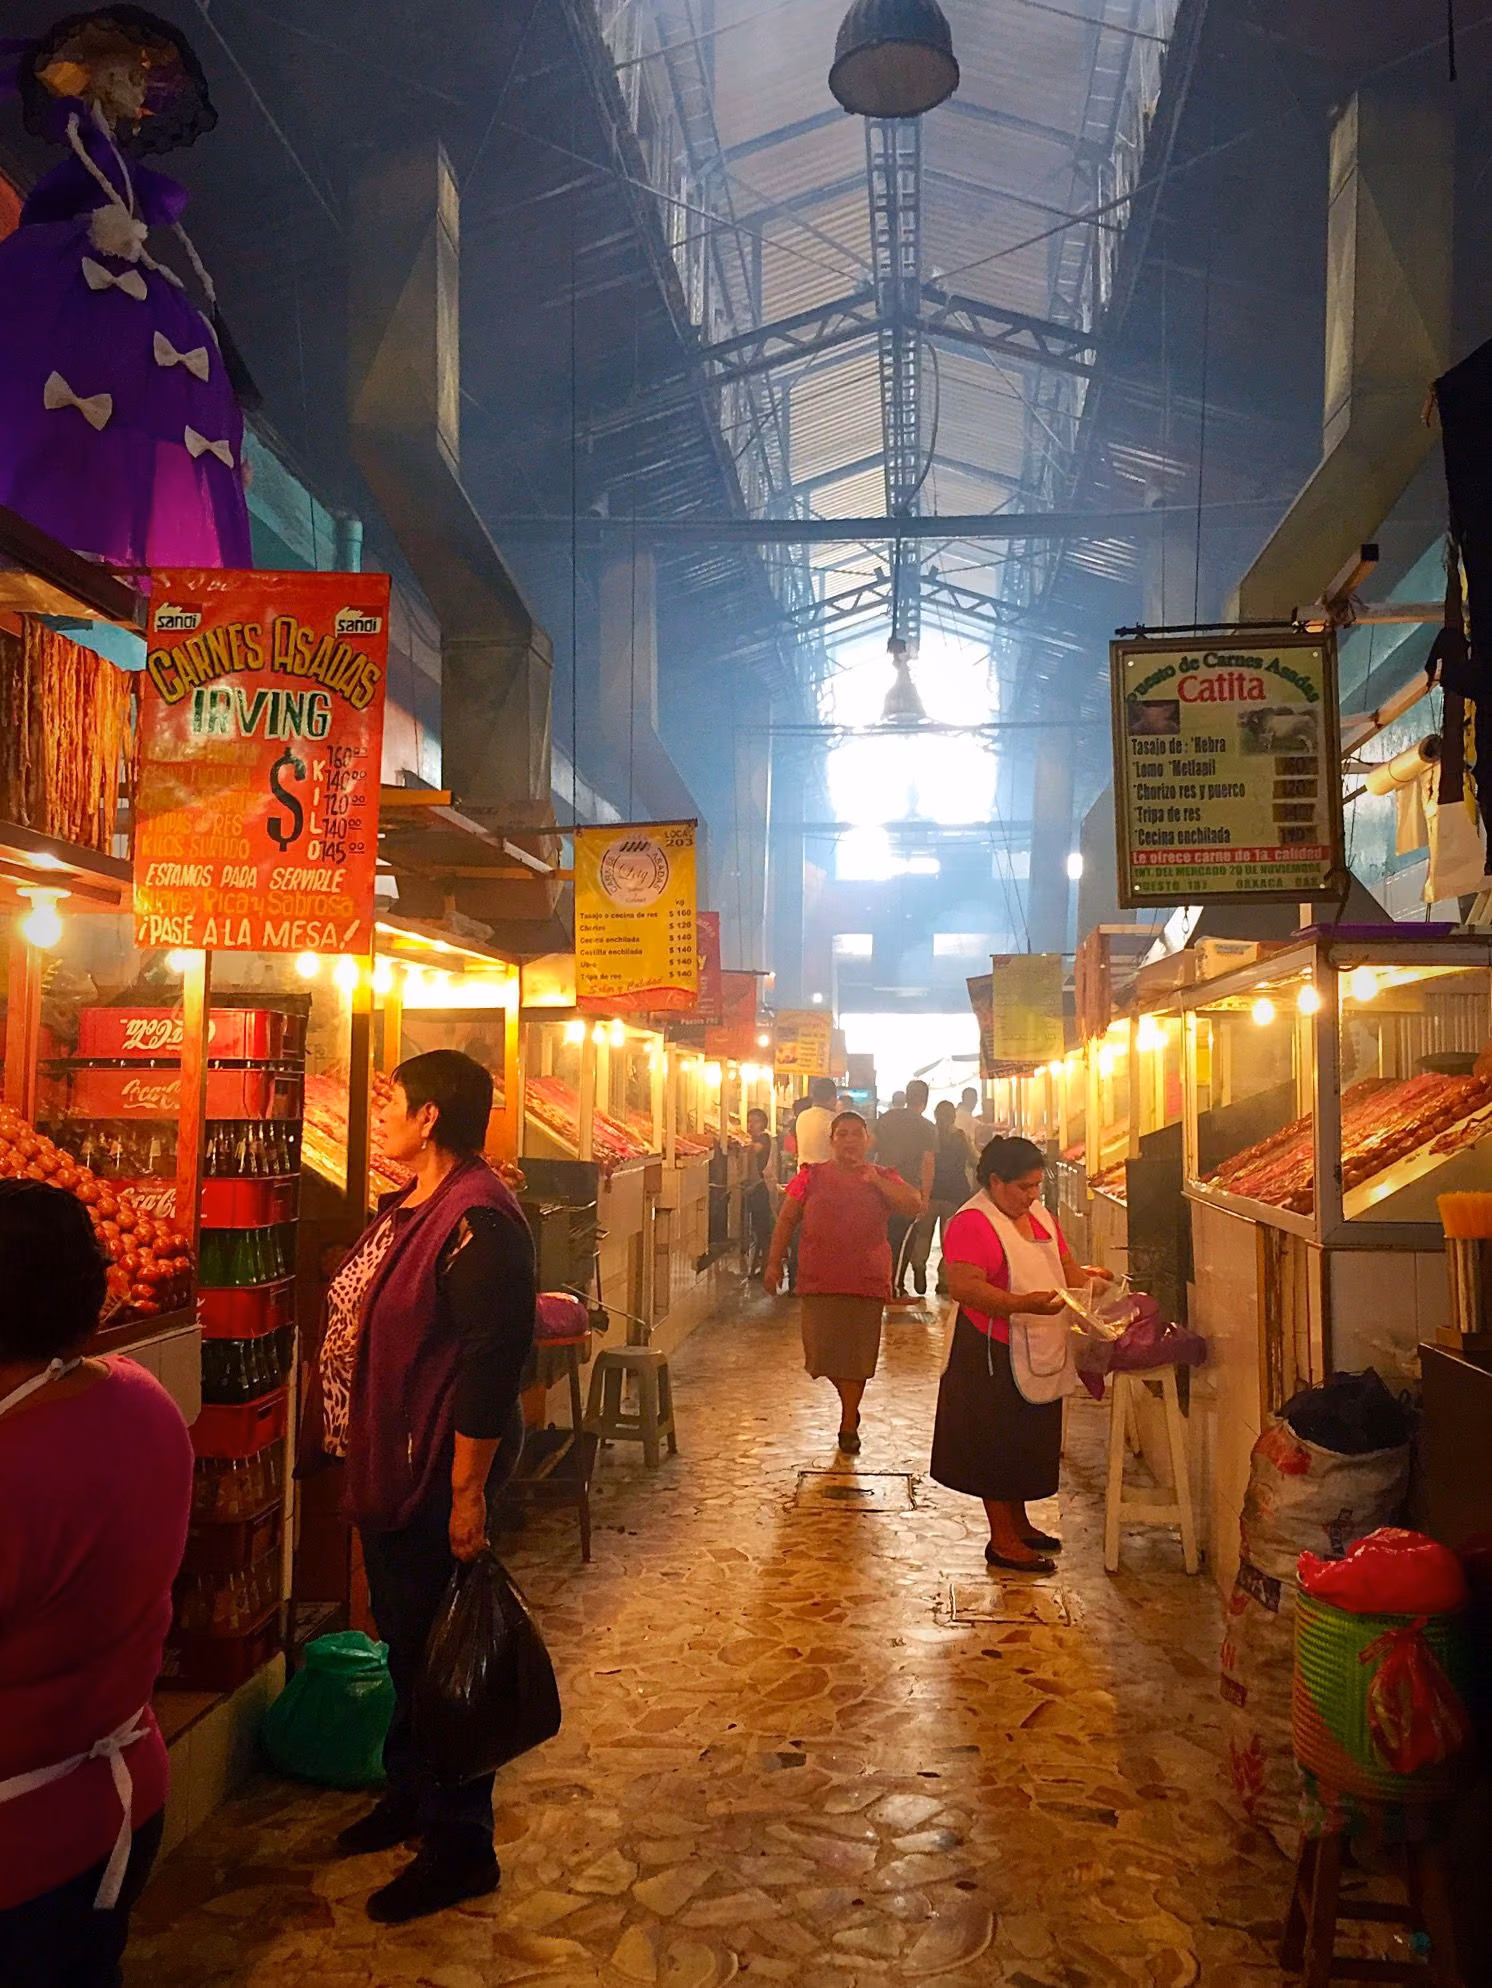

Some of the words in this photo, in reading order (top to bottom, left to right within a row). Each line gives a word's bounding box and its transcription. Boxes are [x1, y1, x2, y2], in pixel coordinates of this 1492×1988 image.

[148, 623, 264, 705] CARNES
[272, 615, 382, 710] ASADAS
[1178, 655, 1200, 673] de
[1202, 651, 1264, 669] Carnes
[1265, 657, 1320, 703] Asadas
[1177, 672, 1266, 703] Catita
[191, 686, 332, 741] IRVING
[1131, 738, 1166, 756] Tasajo
[1179, 785, 1196, 799] res
[1199, 786, 1206, 800] y
[1208, 783, 1245, 800] puerco
[1167, 806, 1181, 822] de
[1183, 807, 1200, 821] res
[666, 838, 694, 847] 203
[1177, 826, 1230, 845] enchilada
[1133, 850, 1147, 865] Le
[1150, 850, 1191, 865] ofrece
[1194, 851, 1231, 864] carne
[1234, 849, 1250, 862] de
[1274, 846, 1322, 860] calidad
[146, 863, 213, 887] ESTAMOS
[220, 865, 257, 889] PARA
[269, 867, 346, 892] SERVIRLE
[652, 852, 665, 891] ASADAS
[1155, 866, 1173, 877] DEL
[1176, 864, 1226, 877] MERCADO
[1229, 864, 1243, 875] 20
[1245, 863, 1258, 875] DE
[1260, 862, 1321, 874] NOVIEMBRE
[203, 886, 249, 912] Rica
[253, 896, 264, 916] y
[268, 889, 353, 916] Sabrosa
[580, 912, 603, 920] Tasajo
[138, 914, 194, 945] ¡PASE
[202, 917, 218, 945] A
[223, 918, 251, 946] LA
[263, 919, 360, 950] MESA!
[605, 936, 641, 944] enchilada
